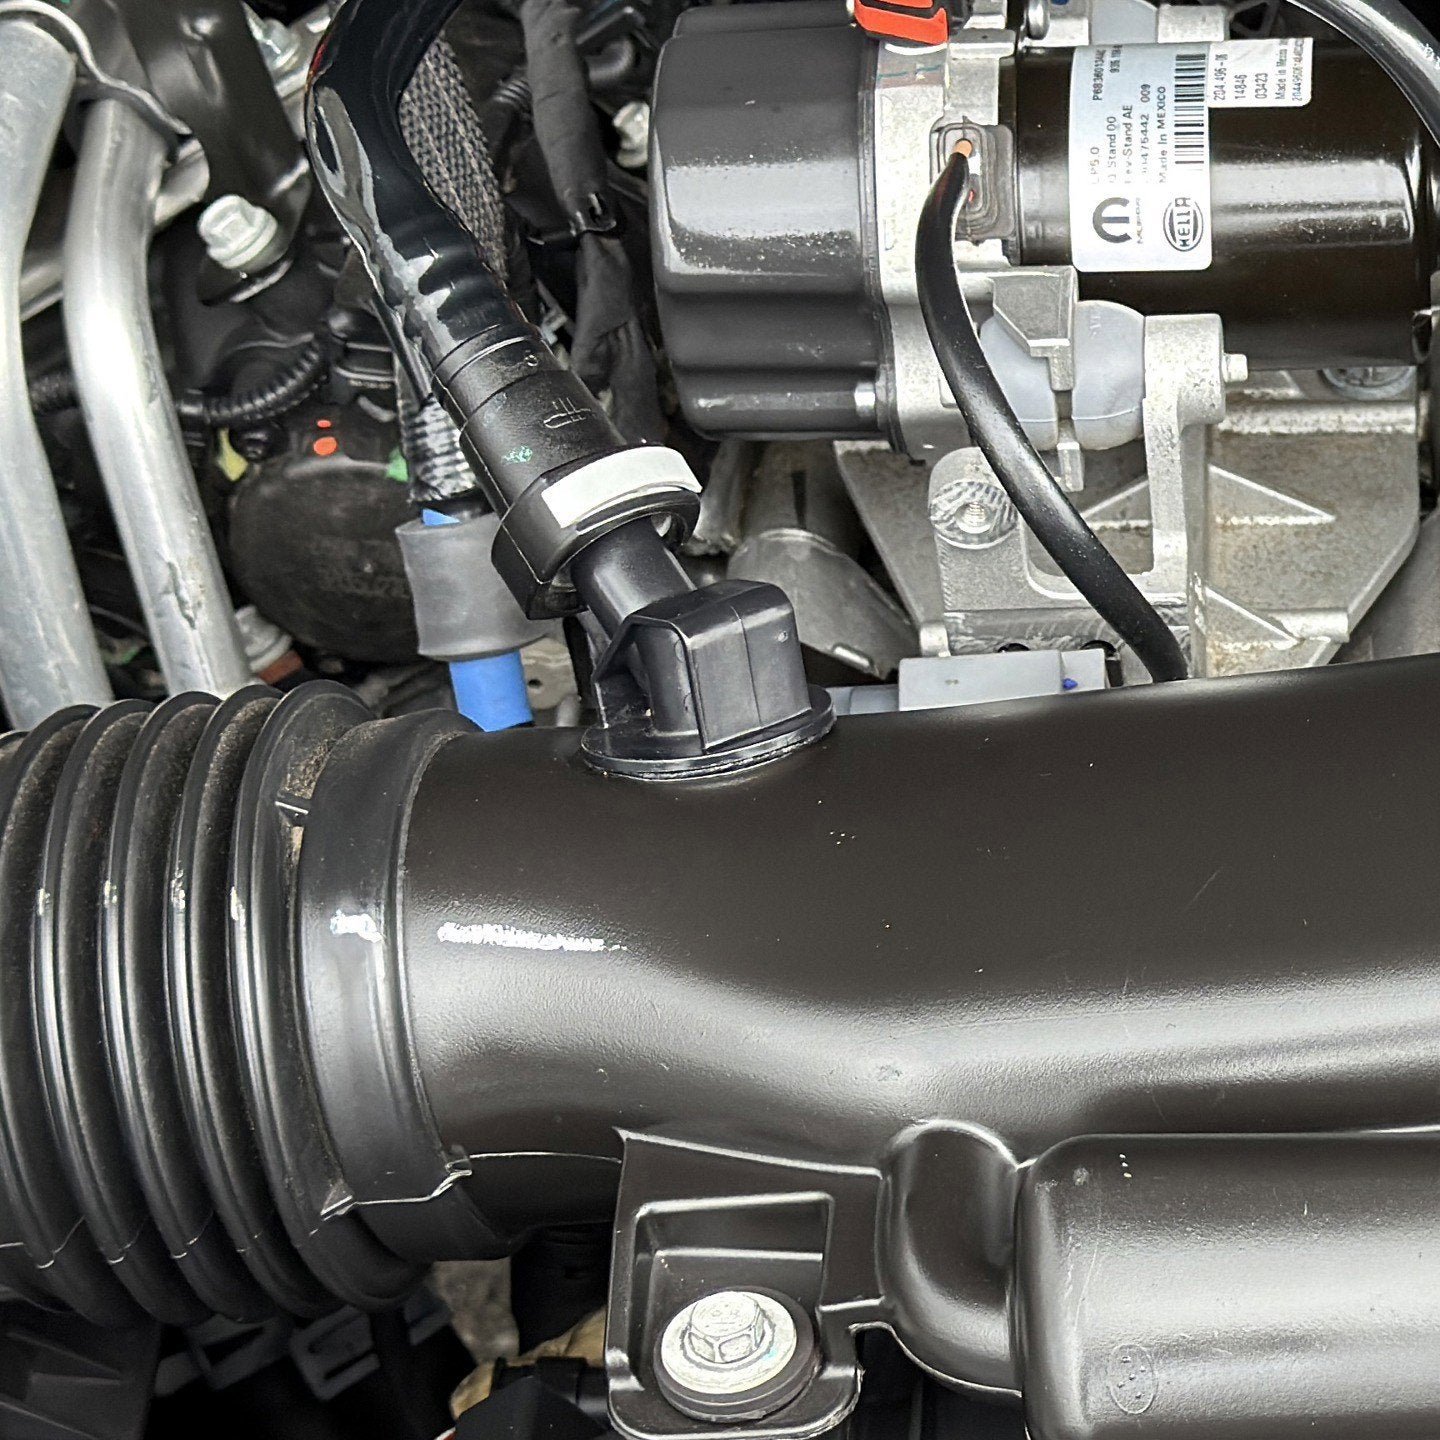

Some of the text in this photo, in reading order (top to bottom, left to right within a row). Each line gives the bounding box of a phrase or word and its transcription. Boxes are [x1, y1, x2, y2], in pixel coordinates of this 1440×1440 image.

[1275, 76, 1286, 101] Made
[1123, 104, 1133, 119] AE
[1158, 86, 1167, 130] MEXICO
[1174, 196, 1192, 248] HELLA
